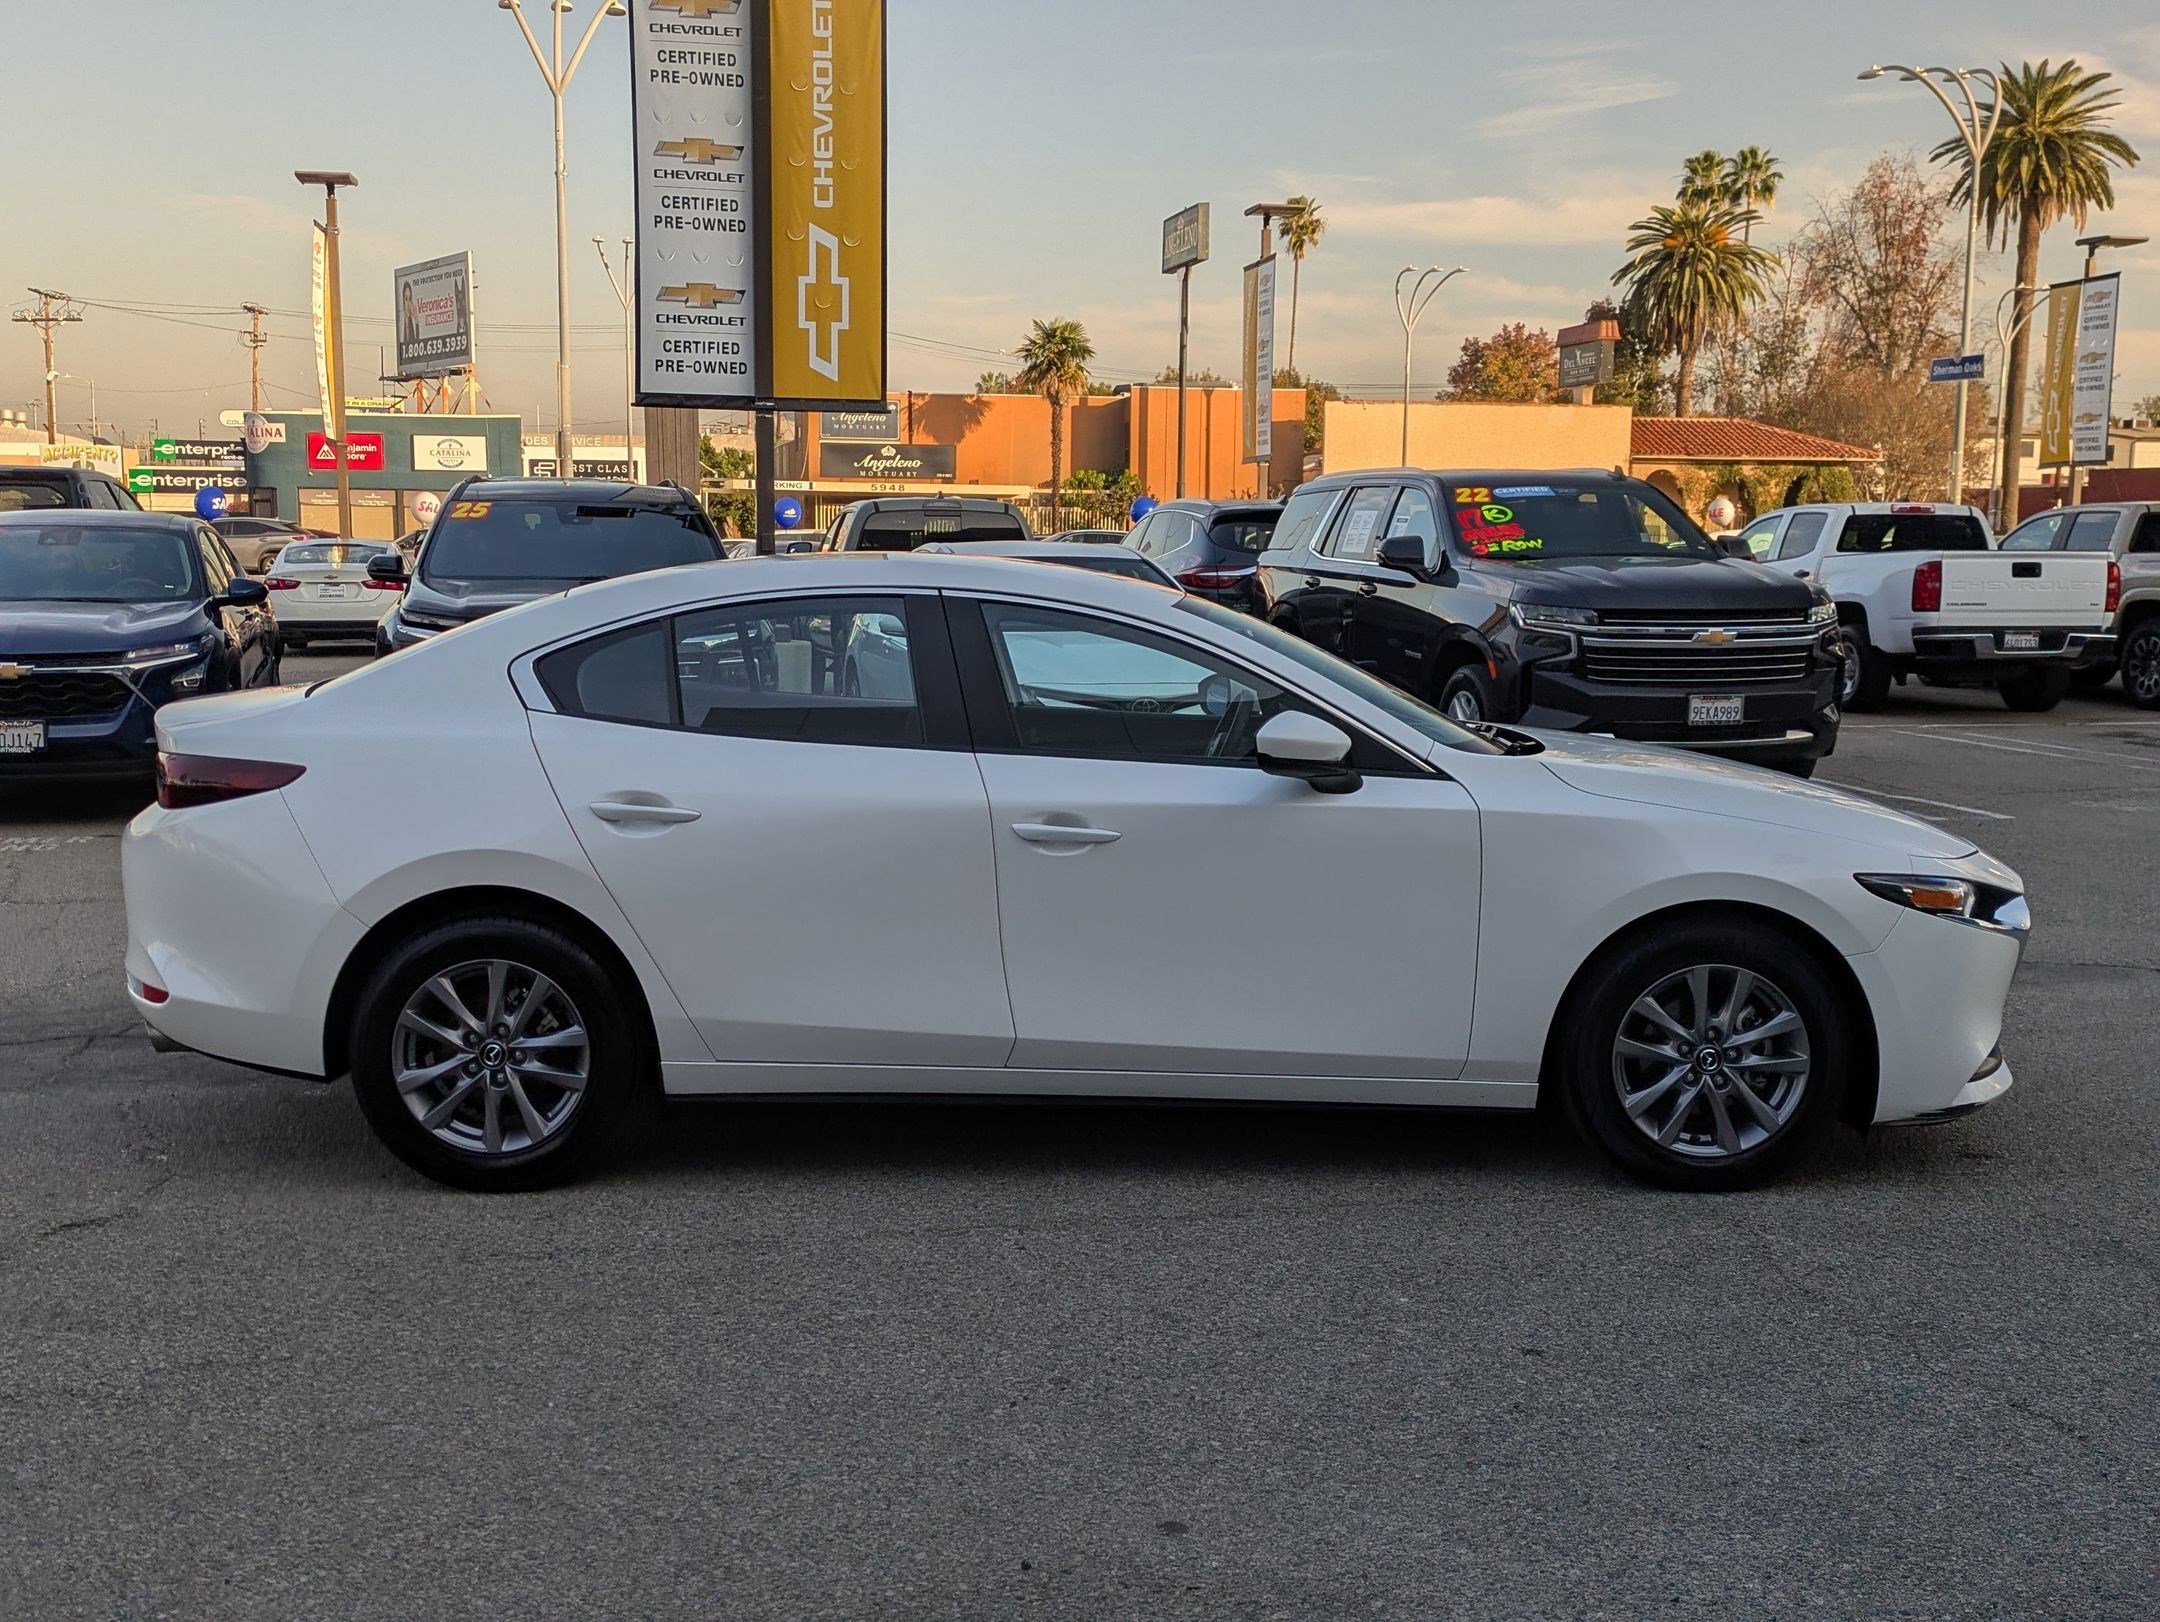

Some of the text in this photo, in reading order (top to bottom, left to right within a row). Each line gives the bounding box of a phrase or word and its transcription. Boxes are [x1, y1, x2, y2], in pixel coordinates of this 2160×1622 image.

[649, 23, 743, 38] CHEVROLET
[657, 49, 737, 67] CERTIFIED
[650, 70, 744, 88] PRE-OWNED
[812, 0, 833, 208] CHEVROLET
[653, 168, 745, 184] CHEVROLET
[661, 195, 739, 212] CERTIFIED
[654, 215, 746, 233] PRE-OWNED
[417, 293, 454, 313] Veronica's
[655, 313, 747, 327] CHEVROLET
[662, 340, 740, 355] CERTIFIED
[655, 360, 747, 375] PRE-OWNED
[832, 411, 886, 424] Angeleno
[347, 443, 377, 453] njamin
[430, 449, 471, 457] CATALINA
[573, 464, 635, 472] RST CLAS
[854, 454, 923, 472] Angeleno
[131, 473, 248, 490] enterprise
[871, 483, 905, 492] 5948
[1456, 487, 1490, 503] 22
[1494, 486, 1549, 495] CERTIFIED
[212, 497, 226, 510] SA
[418, 501, 439, 513] SAL
[451, 502, 492, 519] 25
[1709, 507, 1725, 518] LE
[1951, 581, 2100, 592] CHEVROLET
[1692, 706, 1740, 720] 9EKA989
